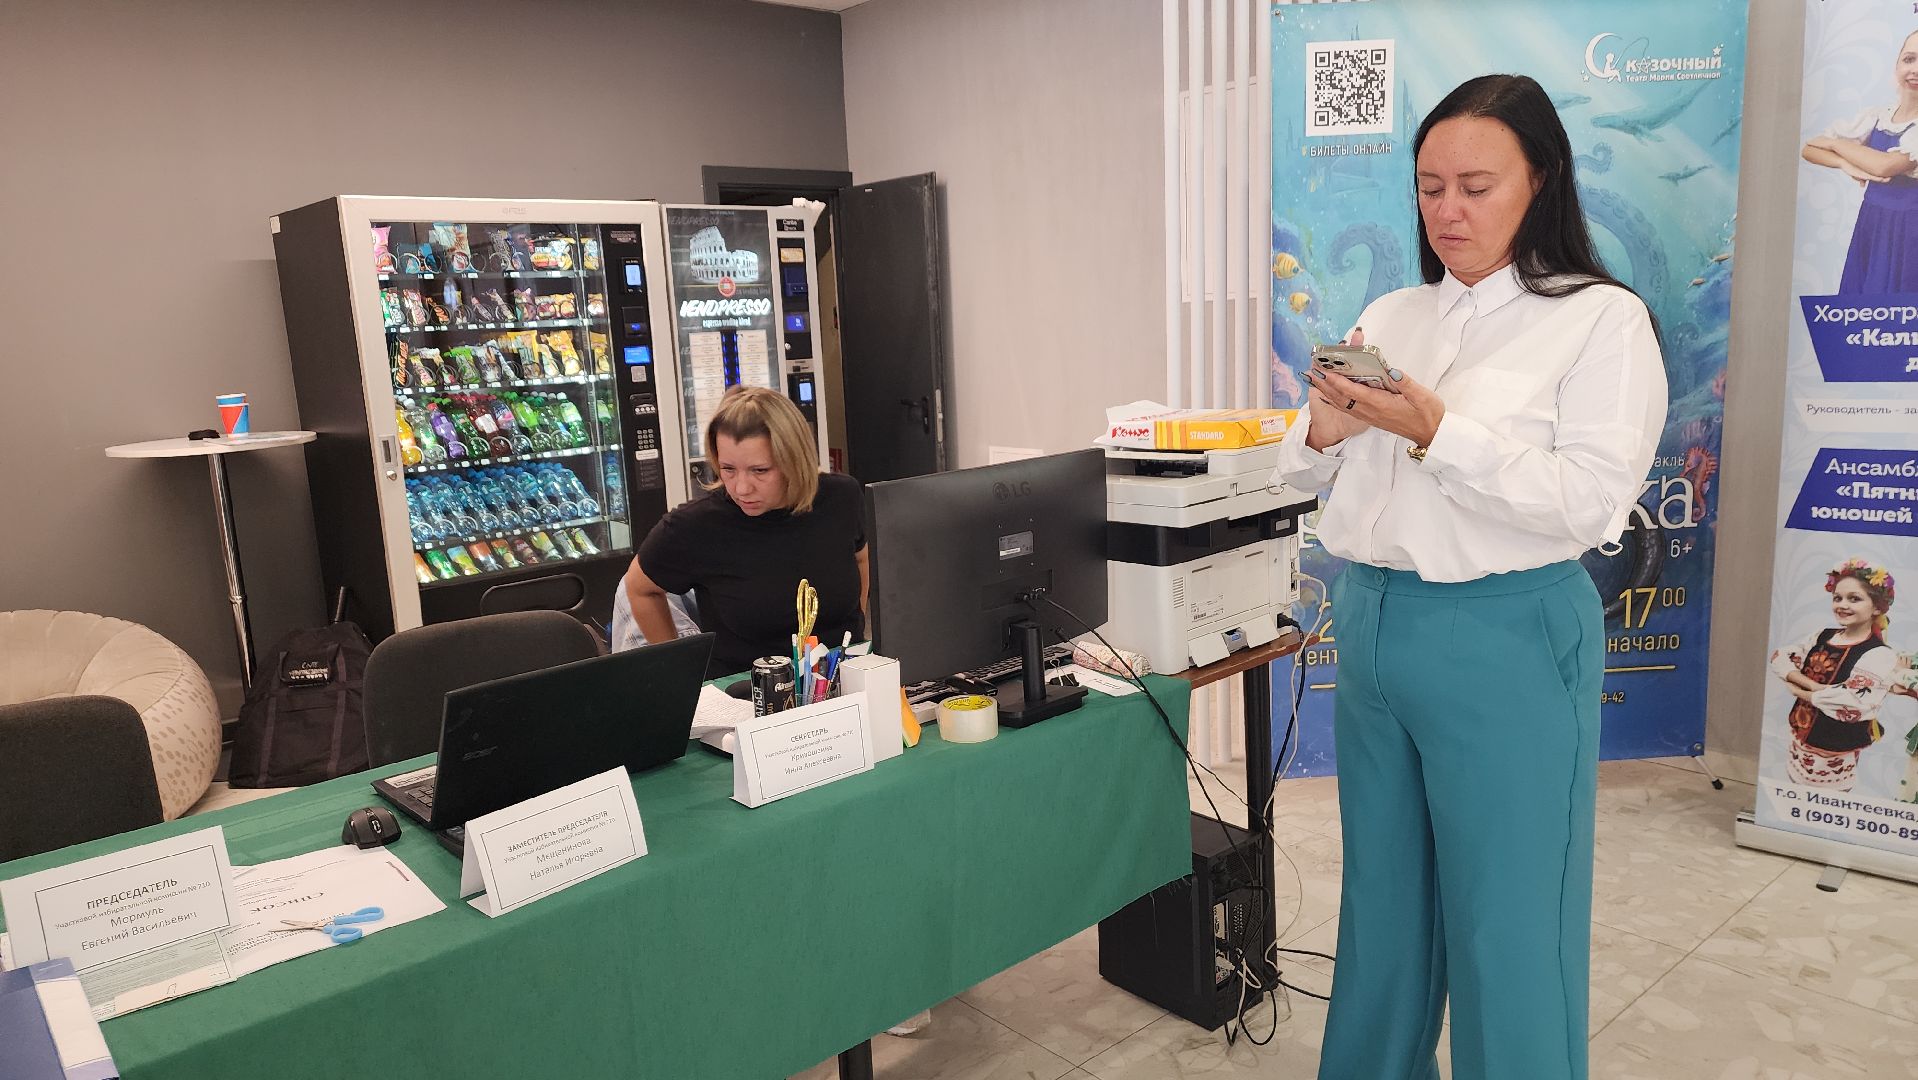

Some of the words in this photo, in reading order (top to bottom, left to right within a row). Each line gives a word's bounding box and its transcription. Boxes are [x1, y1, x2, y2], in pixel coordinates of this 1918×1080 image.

[1310, 145, 1349, 157] БИЛЕТЫ
[1353, 140, 1392, 155] ОНЛАЙН
[680, 298, 771, 318] VENDPRESSO
[1814, 304, 1918, 327] Хореогр
[1807, 403, 1892, 416] Руководитель
[1904, 406, 1918, 415] за
[1190, 431, 1225, 441] STANDARD
[1654, 456, 1686, 468] акль
[1824, 457, 1918, 477] Ансамб
[1012, 481, 1032, 498] LG
[1836, 481, 1918, 502] «Пятн
[1624, 475, 1698, 531] ка
[1811, 506, 1913, 524] юношей
[1670, 539, 1693, 558] 6+
[1607, 634, 1680, 653] начало
[753, 686, 764, 717] АТЬСЯ
[1601, 691, 1625, 704] 9-42
[791, 728, 829, 743] СЕКРЕТАРЬ
[784, 765, 803, 775] Инна
[804, 753, 842, 770] Алексеевна
[1775, 787, 1801, 801] г.о.
[508, 830, 557, 853] ЗАМЕСТИТЕЛЬ
[557, 810, 608, 834] ПРЕДСЕДАТЕЛЯ
[1791, 807, 1801, 818] 8
[1806, 809, 1851, 829] (903)
[1856, 819, 1918, 842] 500-89
[529, 862, 564, 881] Наталья
[565, 846, 604, 867] Игоревна
[87, 877, 178, 910] ПРЕДСЕДАТЕЛЬ
[54, 912, 97, 930] Участковой
[98, 895, 152, 917] избирательной
[152, 887, 187, 904] комиссии
[188, 883, 196, 893] №
[110, 906, 164, 928] Мормуль
[81, 928, 130, 951] Евгений
[131, 910, 198, 936] Васильевич
